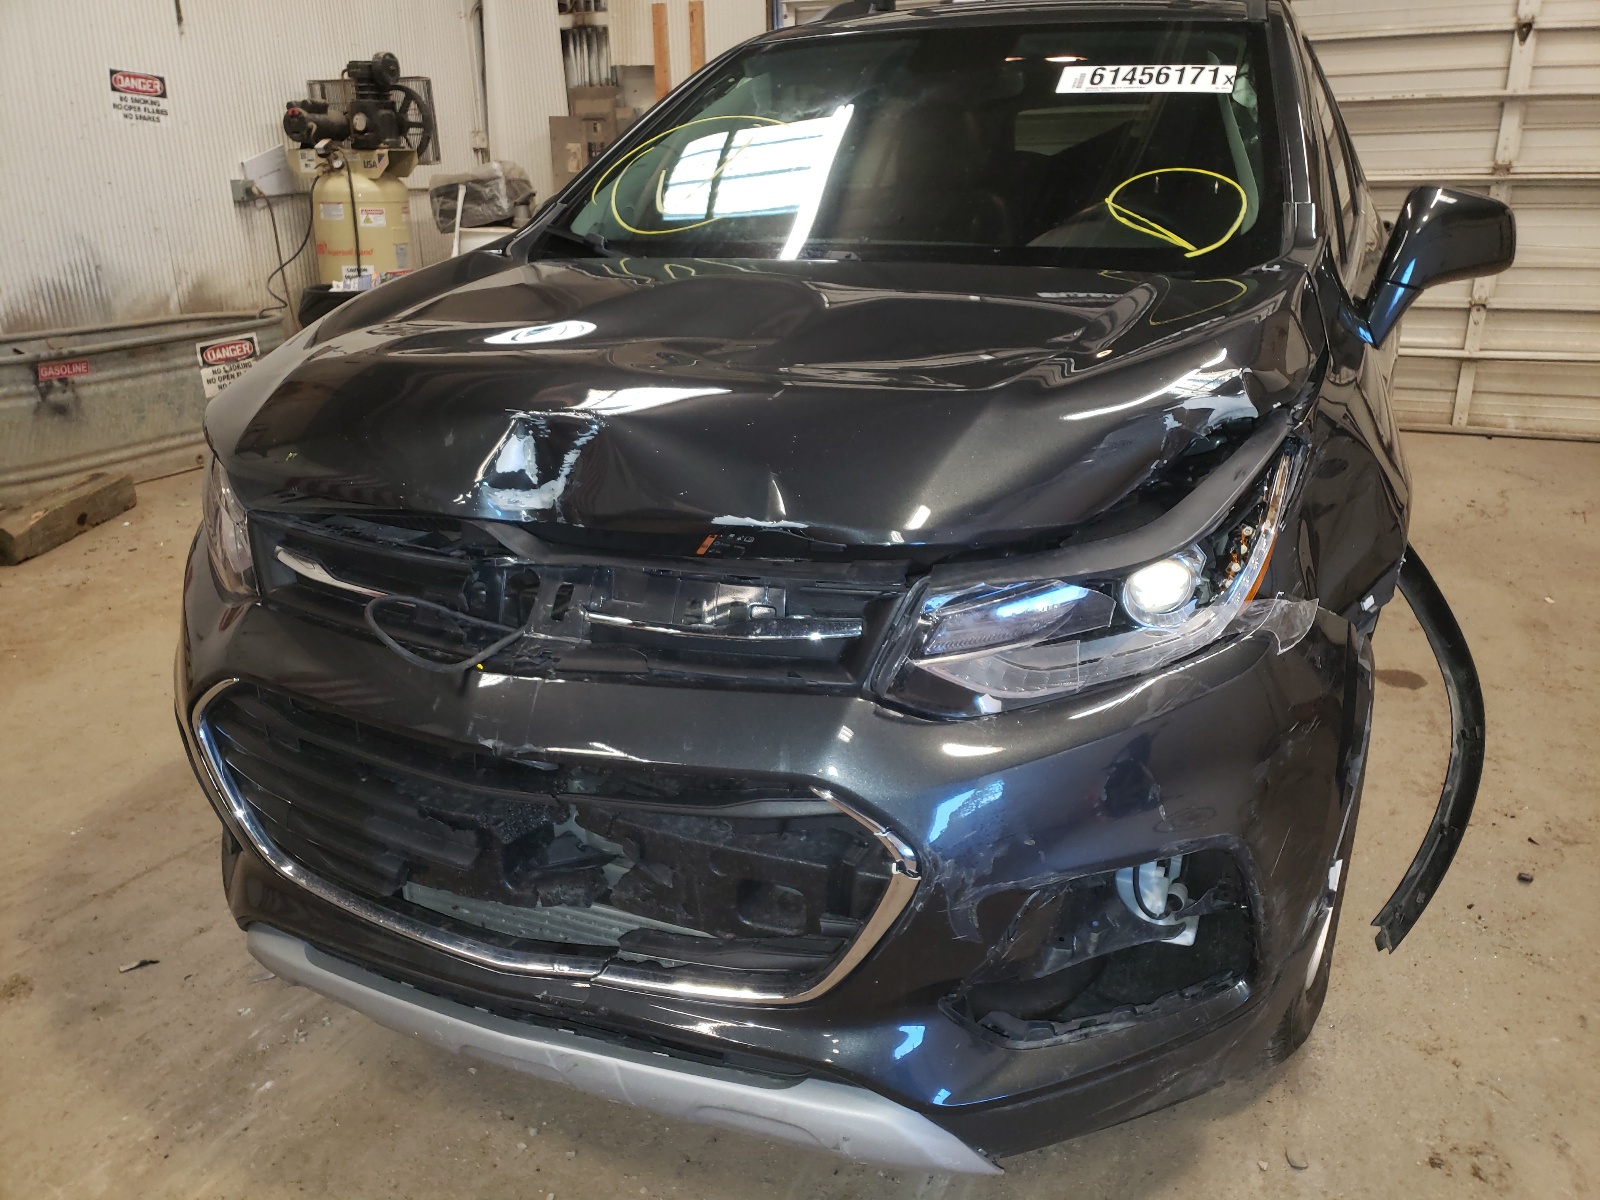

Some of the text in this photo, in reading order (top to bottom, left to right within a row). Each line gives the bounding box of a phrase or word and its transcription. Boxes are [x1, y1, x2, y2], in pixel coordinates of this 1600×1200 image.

[116, 74, 161, 93] DANGER
[1089, 66, 1220, 86] 61456171
[363, 159, 377, 169] USA
[206, 342, 252, 361] DANGER
[40, 362, 88, 378] GASOLINE
[211, 367, 222, 375] NO
[206, 377, 216, 385] NO
[217, 373, 235, 383] OPEN
